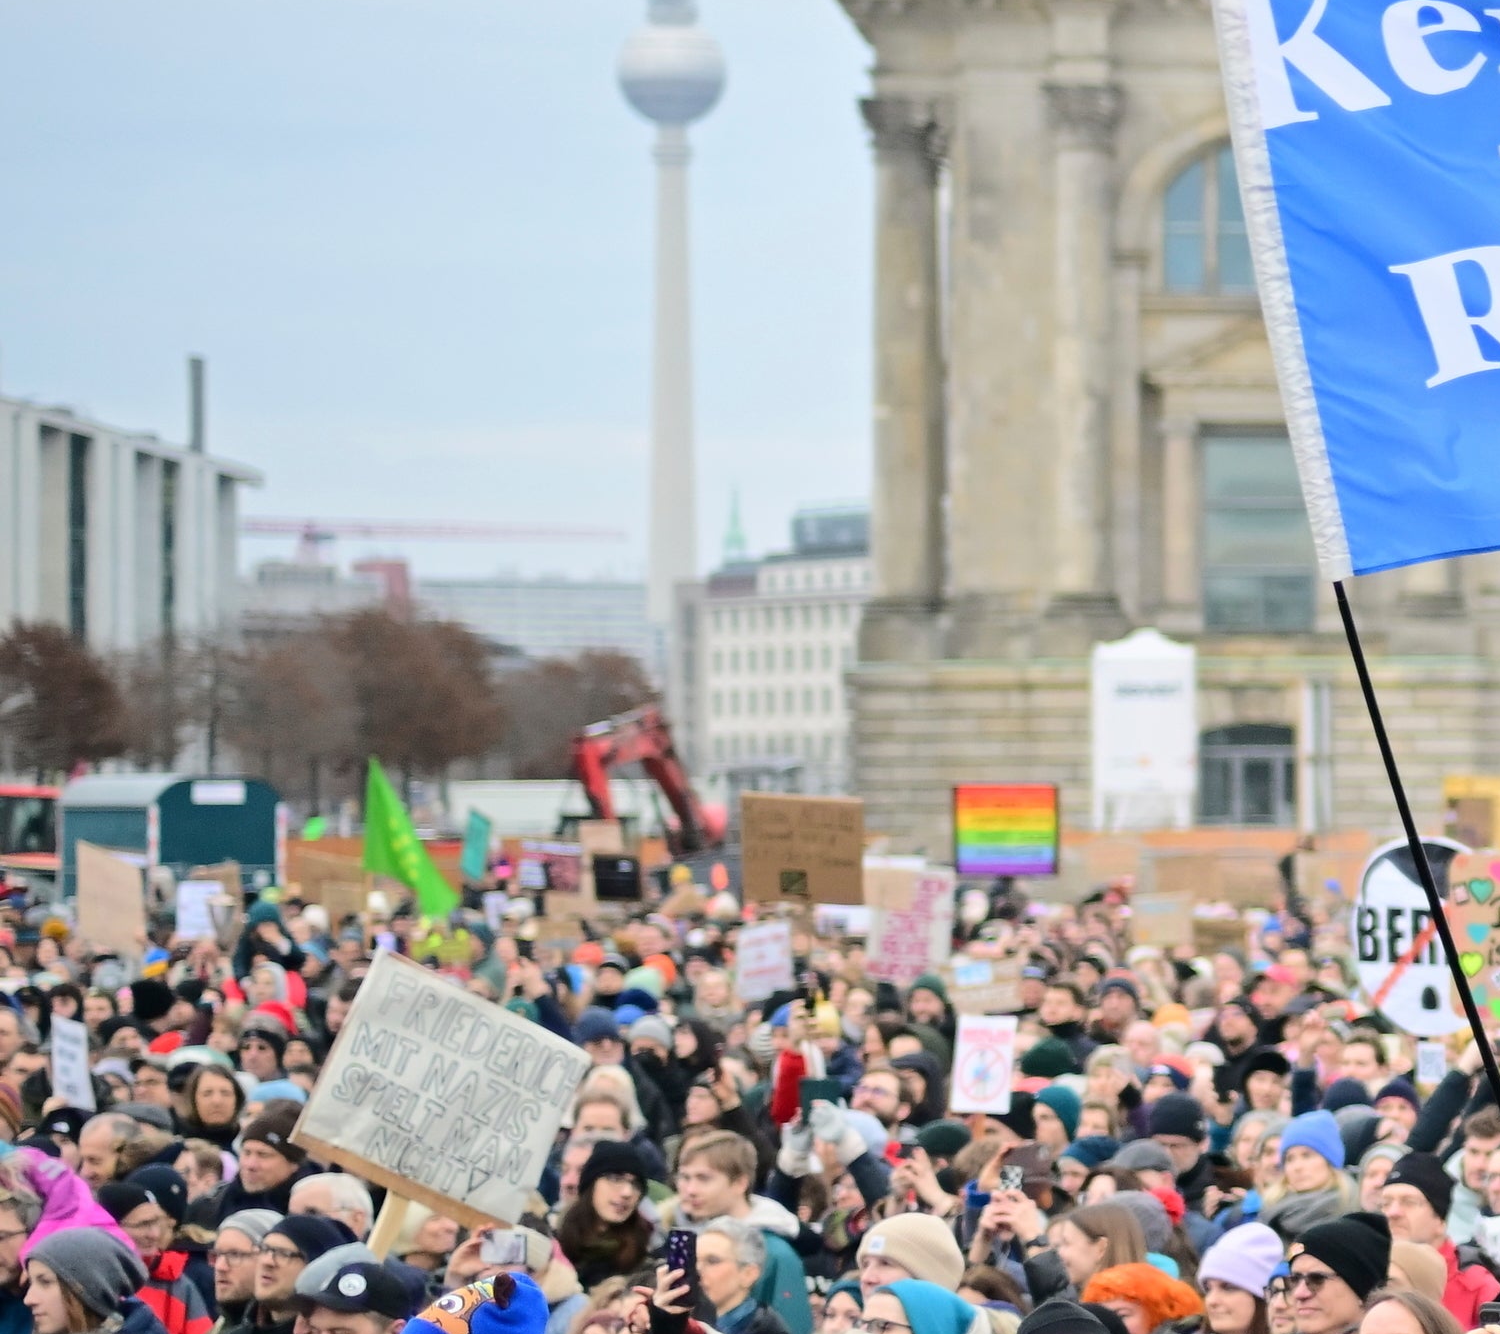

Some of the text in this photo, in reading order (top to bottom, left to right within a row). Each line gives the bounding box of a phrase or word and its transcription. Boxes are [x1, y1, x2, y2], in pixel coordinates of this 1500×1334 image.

[349, 1020, 420, 1077] MIT
[331, 1062, 447, 1141] SPIELT
[420, 1051, 543, 1145] NAZIS
[443, 1118, 533, 1185] MAN
